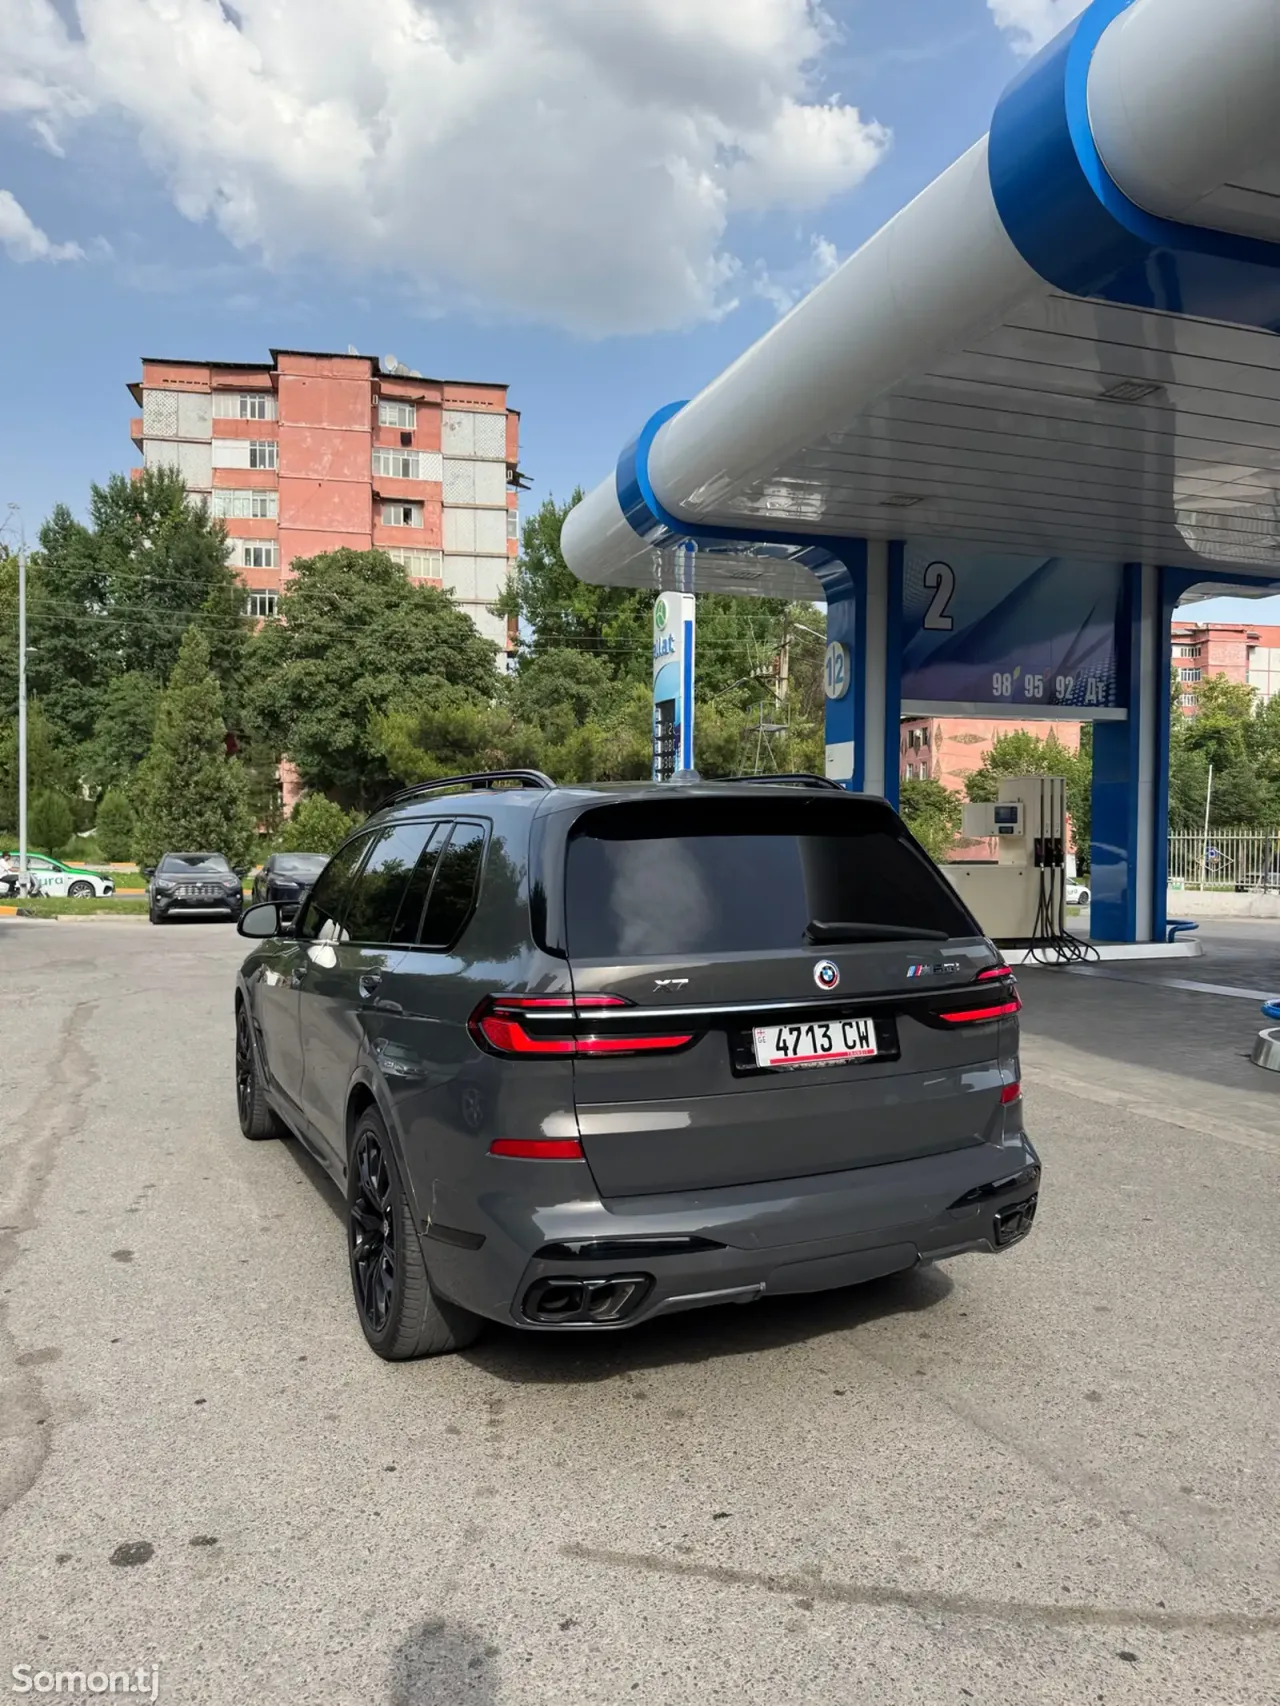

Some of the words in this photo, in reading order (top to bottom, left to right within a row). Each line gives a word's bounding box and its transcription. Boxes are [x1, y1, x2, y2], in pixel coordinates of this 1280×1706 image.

[923, 561, 956, 631] 2
[992, 673, 1012, 697] 98
[1024, 674, 1044, 698] 95
[1055, 676, 1074, 699] 92
[652, 978, 689, 993] X7
[775, 1024, 833, 1057] 4713
[841, 1020, 870, 1049] CW
